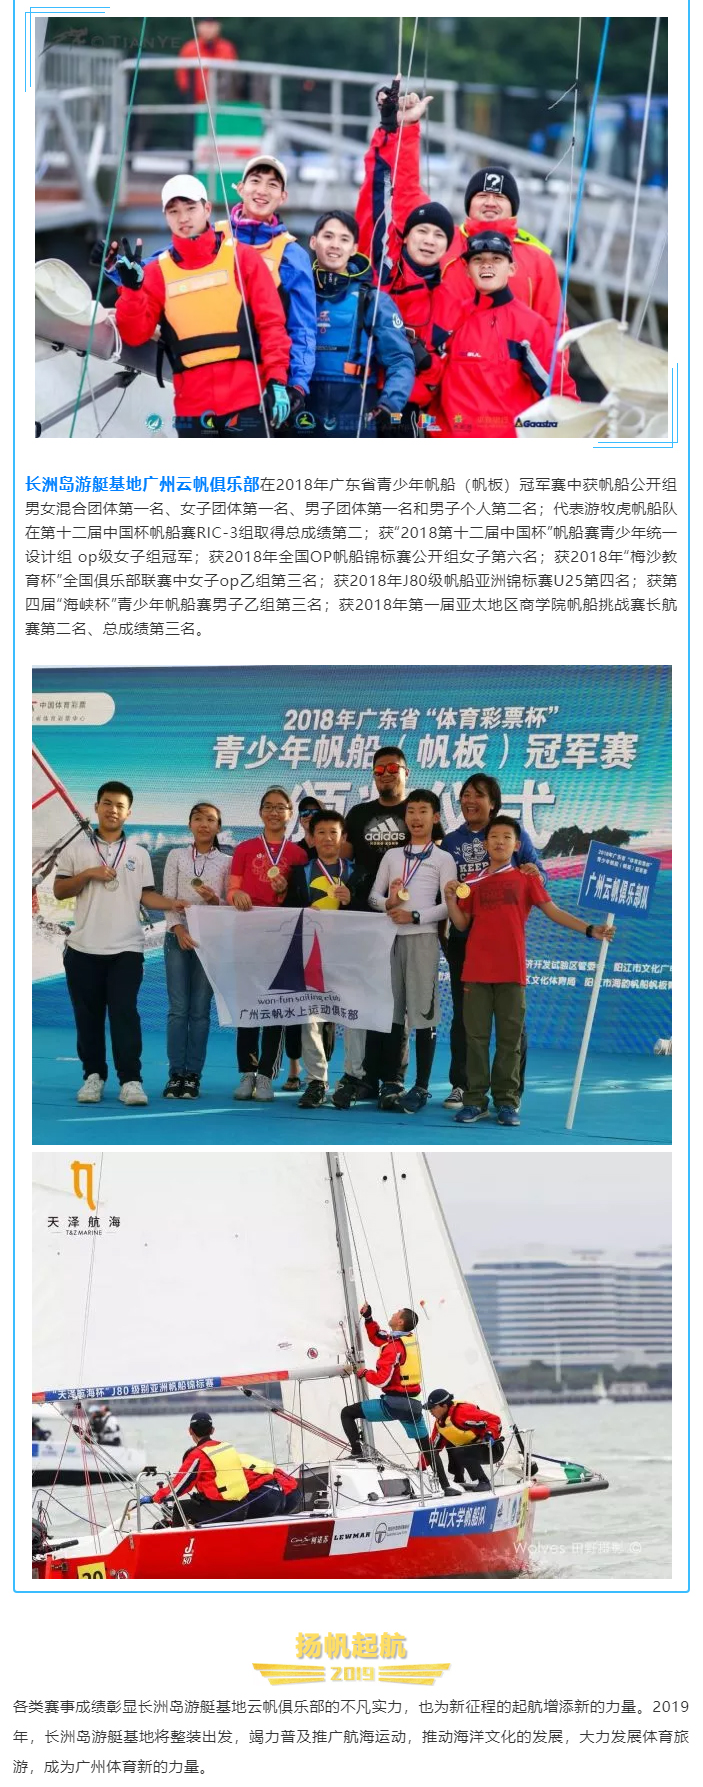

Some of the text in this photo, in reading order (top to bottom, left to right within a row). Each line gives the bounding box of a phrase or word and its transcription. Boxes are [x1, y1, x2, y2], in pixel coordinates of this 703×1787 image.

[25, 501, 678, 517] 男女混合团体第一名、女子团体第一名、男子团体第一名和男子个人第二名；代表游牧虎帆船队
[25, 621, 202, 637] 赛第二名、总成绩第三名。
[39, 700, 87, 710] 中国体育彩票
[364, 831, 406, 842] adidas
[585, 871, 650, 910] 广州云帆俱乐部队
[239, 1004, 359, 1021] 广州云帆水上运动俱乐部
[111, 1385, 129, 1397] J80
[131, 1378, 214, 1397] 级别亚洲帆船锦标赛
[429, 1505, 486, 1529] 中山大学帆船队
[13, 1699, 689, 1714] 各类赛事成绩彰显长洲岛游艇基地云帆俱乐部的不凡实力，也为新征程的起航增添新的力量。2019
[13, 1729, 690, 1744] 年，长洲岛游艇基地将整装出发，竭力普及推广航海运动，推动海洋文化的发展，大力发展体育旅
[13, 1759, 205, 1774] 游，成为广州体育新的力量。
